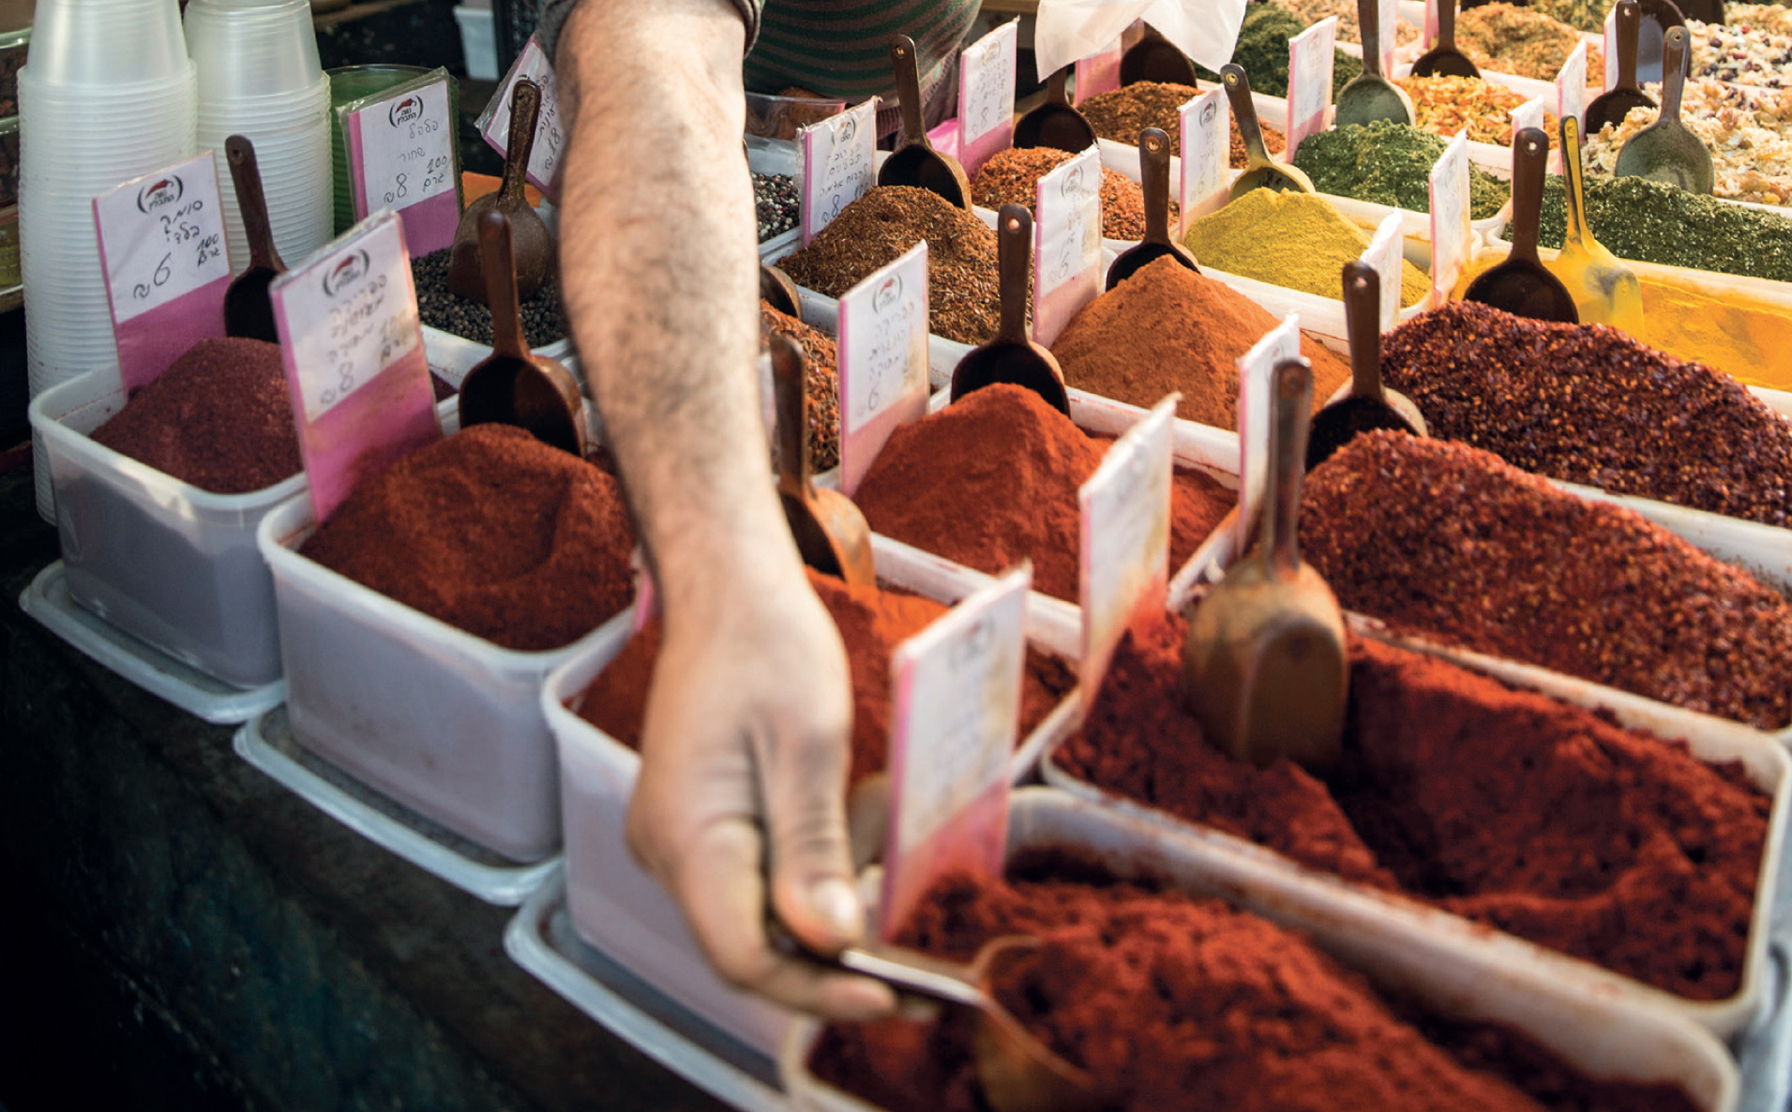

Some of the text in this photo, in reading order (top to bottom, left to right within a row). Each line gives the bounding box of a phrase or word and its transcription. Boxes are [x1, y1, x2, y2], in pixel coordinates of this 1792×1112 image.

[409, 118, 439, 139] פלפל
[548, 127, 561, 156] 18
[397, 146, 426, 162] שחור
[427, 155, 448, 174] 100
[396, 172, 408, 198] 8
[422, 173, 445, 192] גרם
[831, 194, 841, 218] 8
[196, 233, 219, 252] 100
[197, 247, 220, 267] גרם
[153, 252, 172, 286] 6
[339, 361, 354, 392] 8
